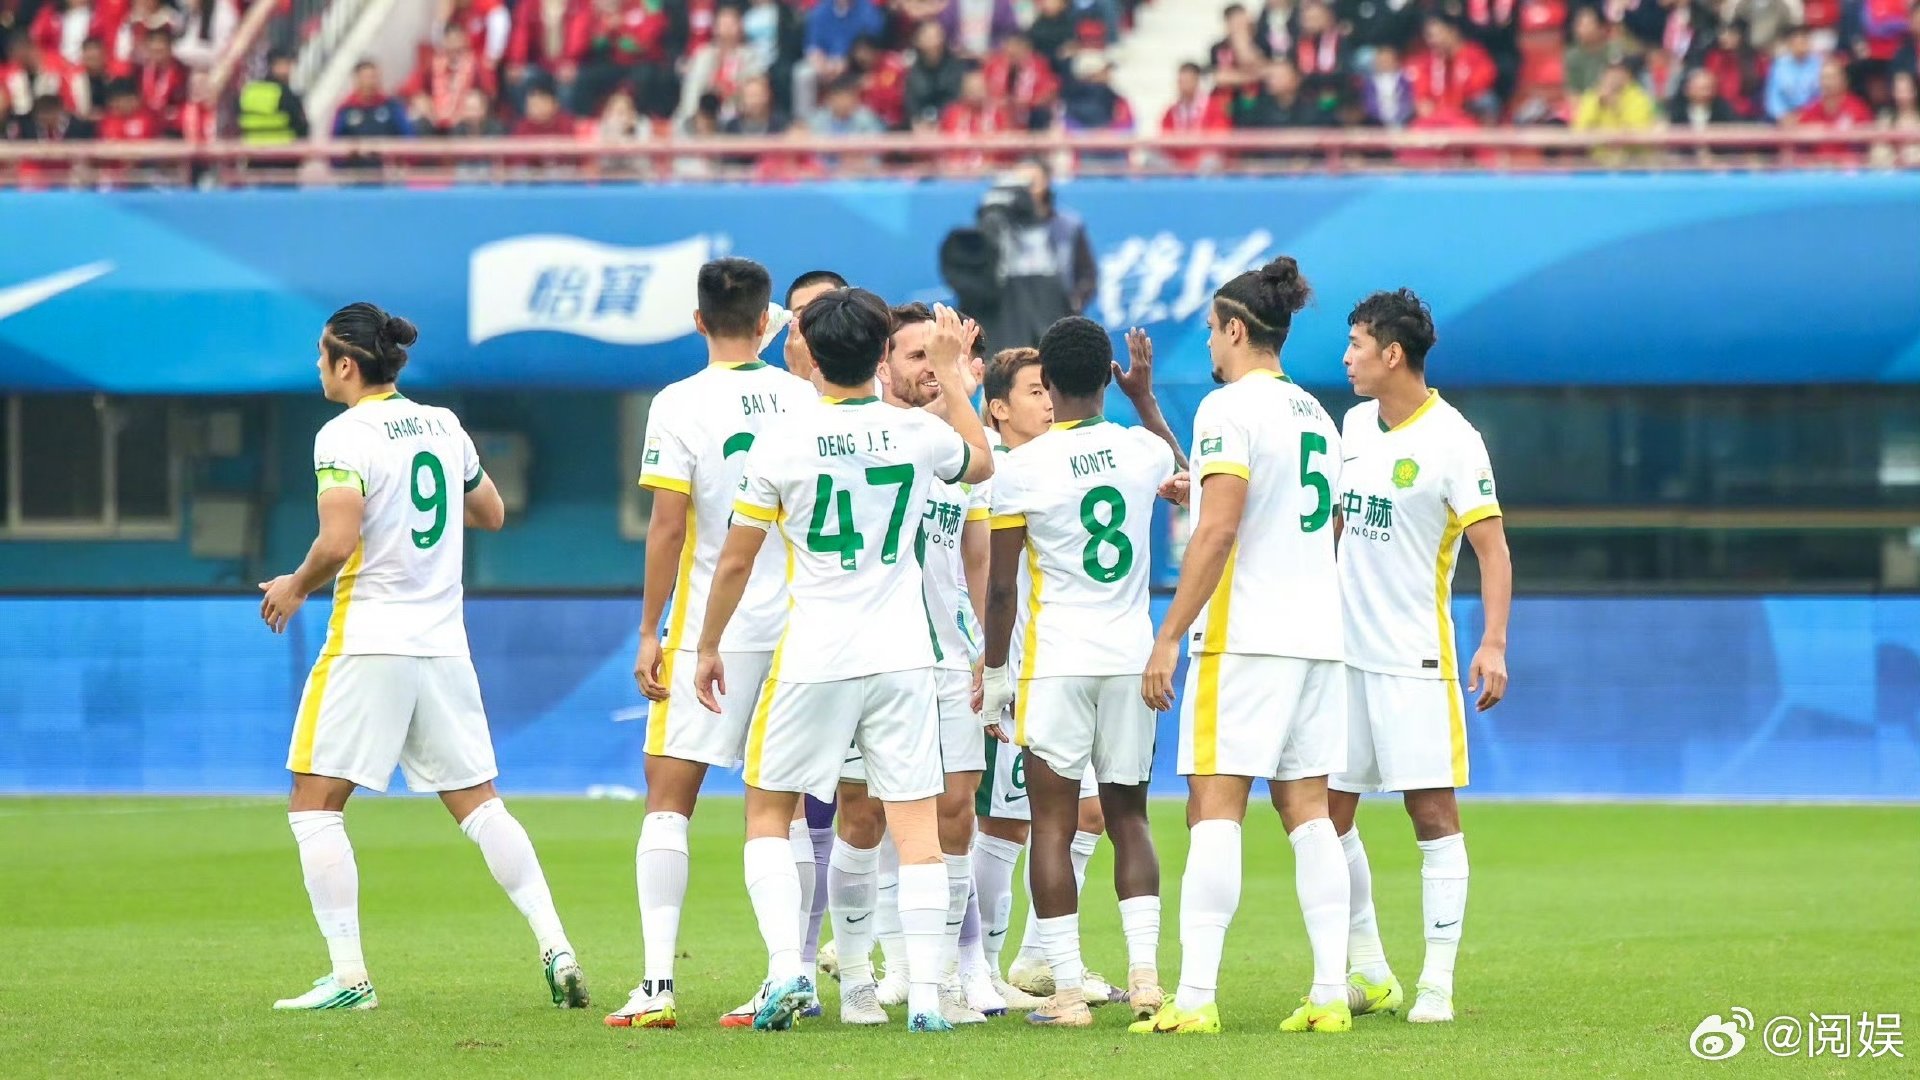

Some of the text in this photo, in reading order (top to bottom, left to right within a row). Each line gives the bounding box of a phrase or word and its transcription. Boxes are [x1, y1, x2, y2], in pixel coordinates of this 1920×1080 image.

[741, 393, 786, 415] BAI Y.
[384, 416, 423, 440] ZHANG
[817, 433, 856, 457] DENG
[1069, 449, 1116, 478] KONTE
[1300, 431, 1331, 533] 5
[410, 451, 447, 549] 9
[807, 463, 915, 571] 47
[1342, 488, 1393, 529] 中赫
[1080, 485, 1133, 583] 8
